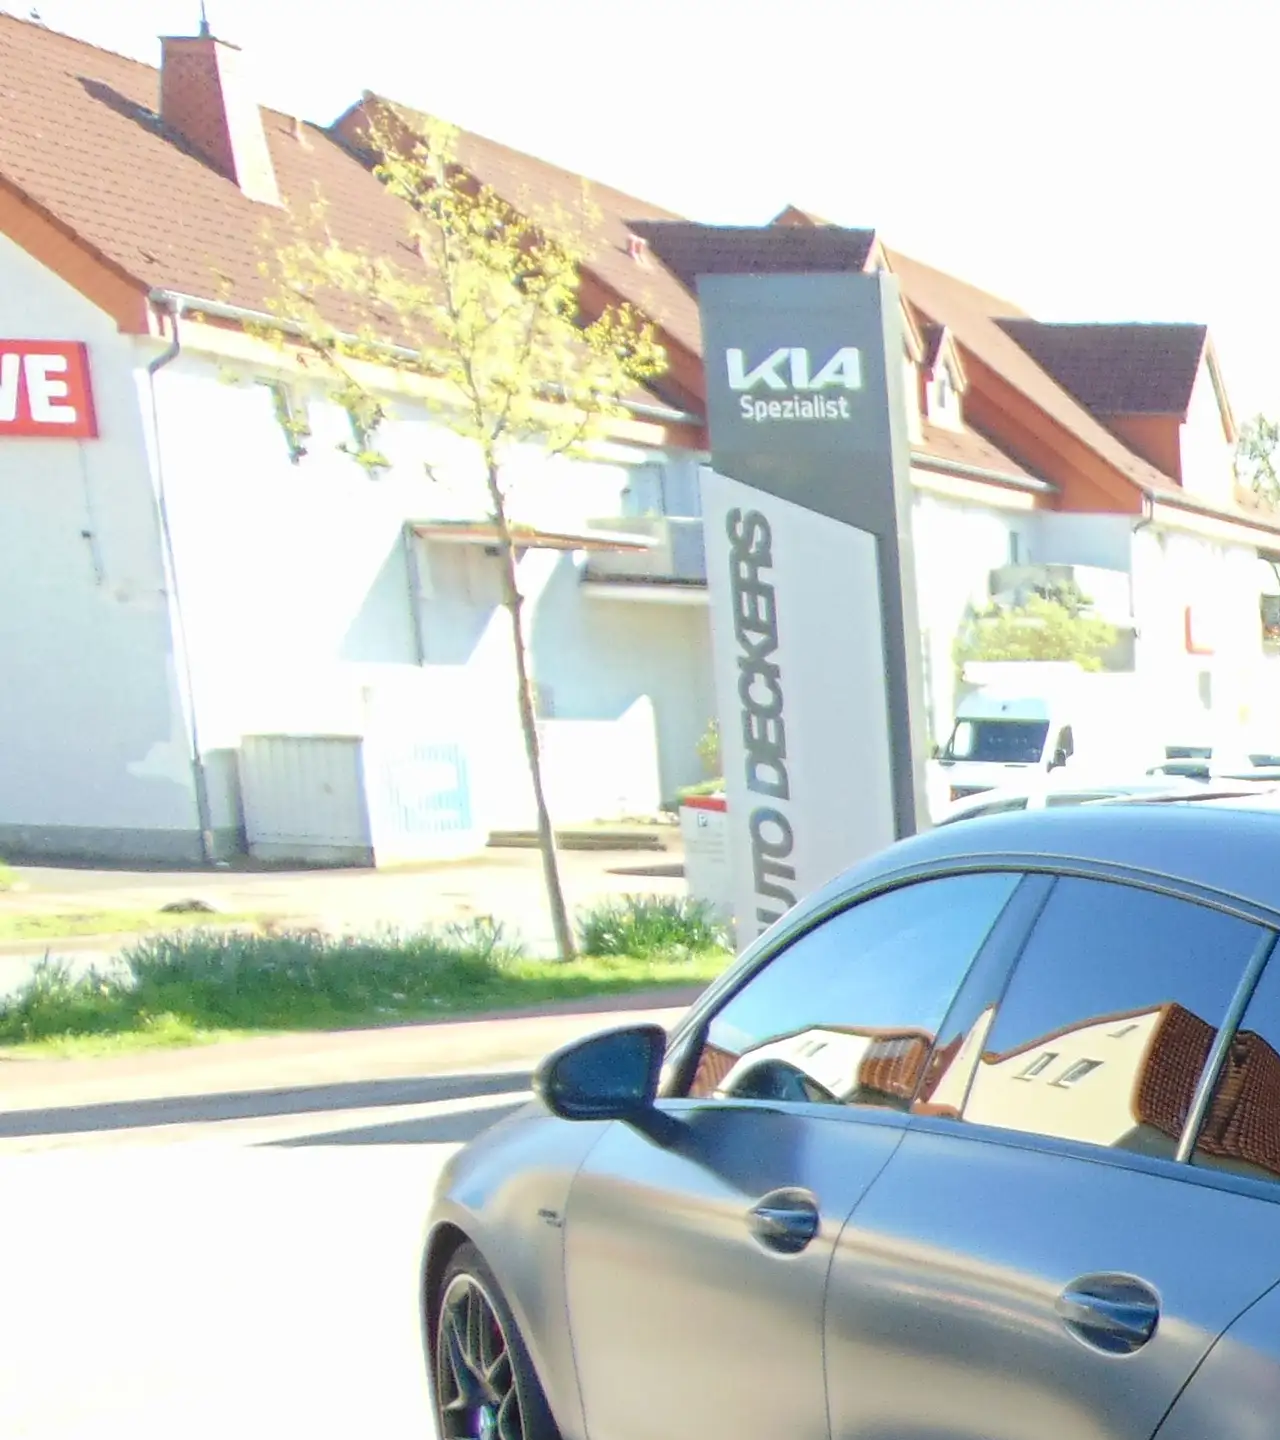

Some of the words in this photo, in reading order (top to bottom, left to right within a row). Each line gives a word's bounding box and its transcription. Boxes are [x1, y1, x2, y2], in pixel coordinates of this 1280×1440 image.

[726, 347, 863, 391] KIA
[740, 394, 850, 422] Spezialist
[725, 507, 791, 800] DECKERS
[749, 806, 800, 937] UTO
